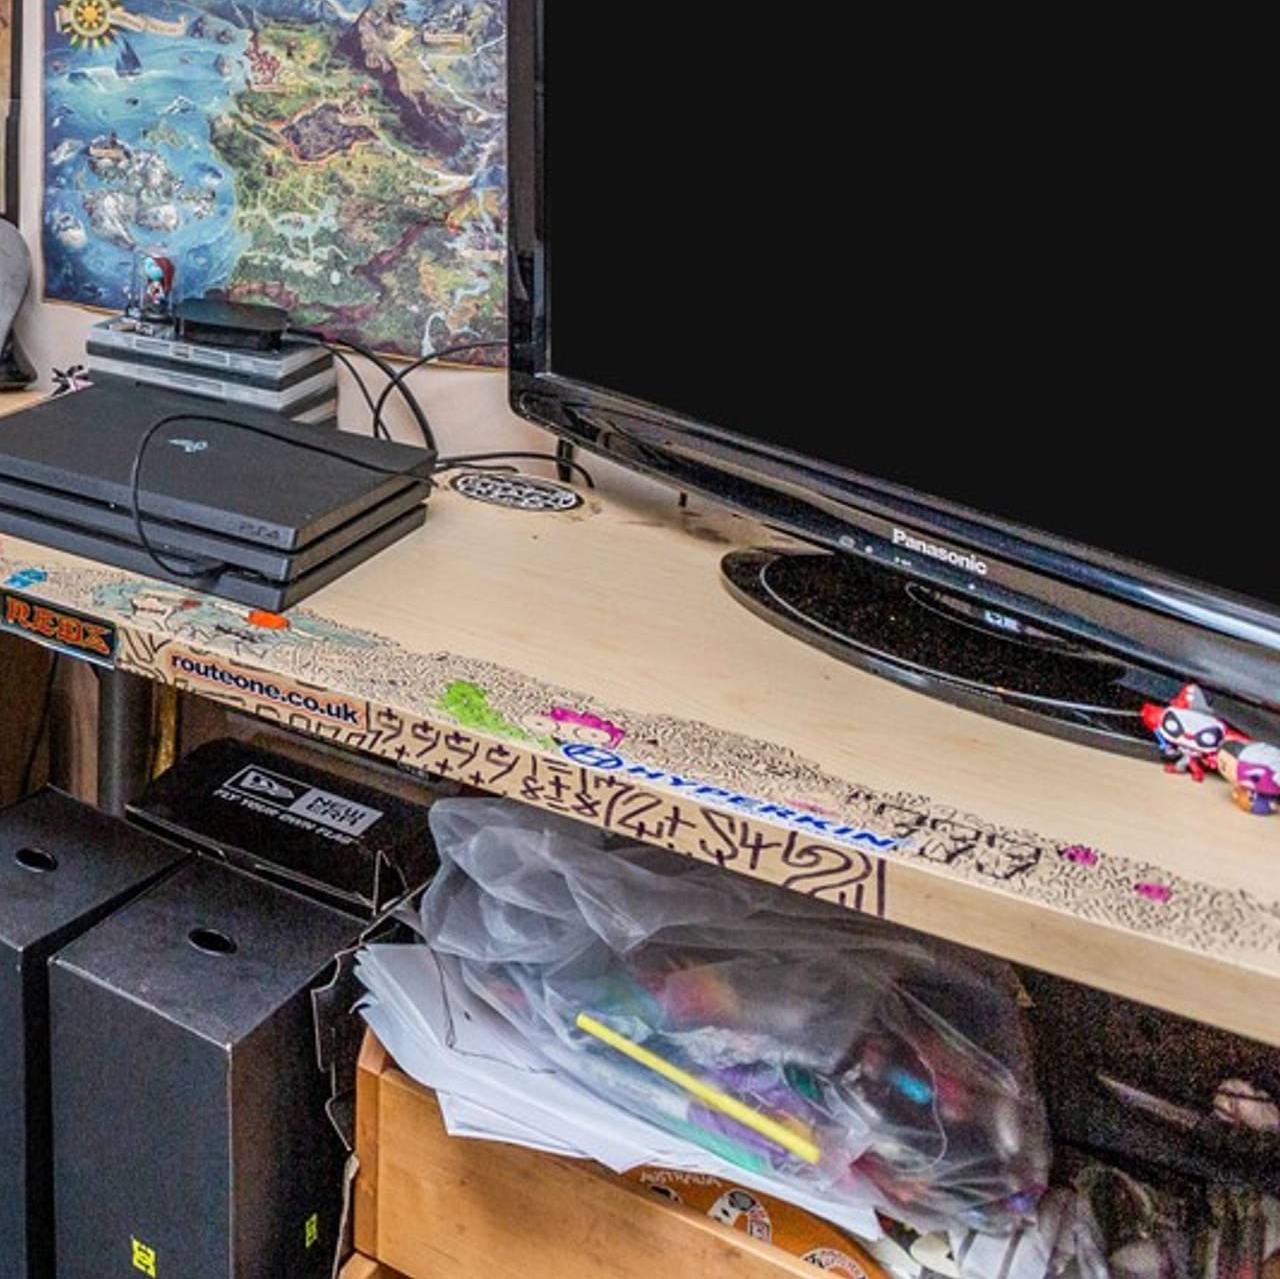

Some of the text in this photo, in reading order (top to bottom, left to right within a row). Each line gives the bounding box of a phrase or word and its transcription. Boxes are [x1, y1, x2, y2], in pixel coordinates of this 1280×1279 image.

[892, 527, 987, 575] Panasonic
[170, 653, 360, 724] routeone.co.uk
[627, 765, 896, 850] HYPERKIN
